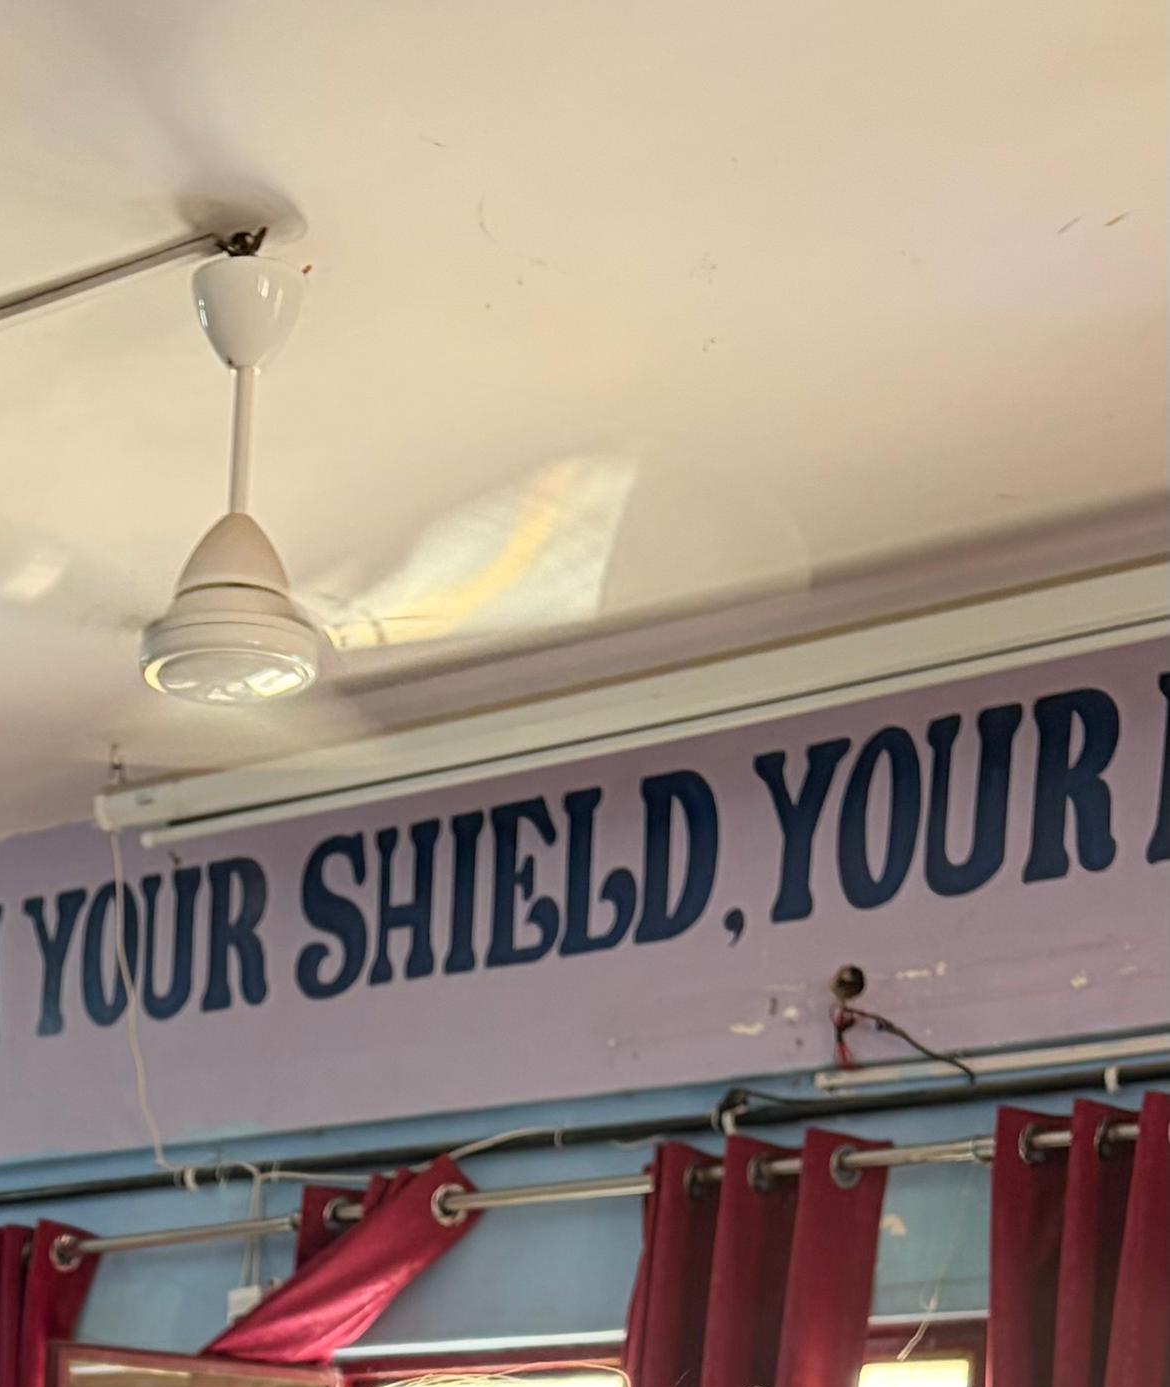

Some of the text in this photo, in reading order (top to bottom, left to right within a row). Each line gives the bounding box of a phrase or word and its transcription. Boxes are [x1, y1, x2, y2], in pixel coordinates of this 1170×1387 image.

[21, 855, 268, 1036] YOUR
[295, 768, 745, 1001] SHIELD,
[751, 687, 1121, 924] YOUR
